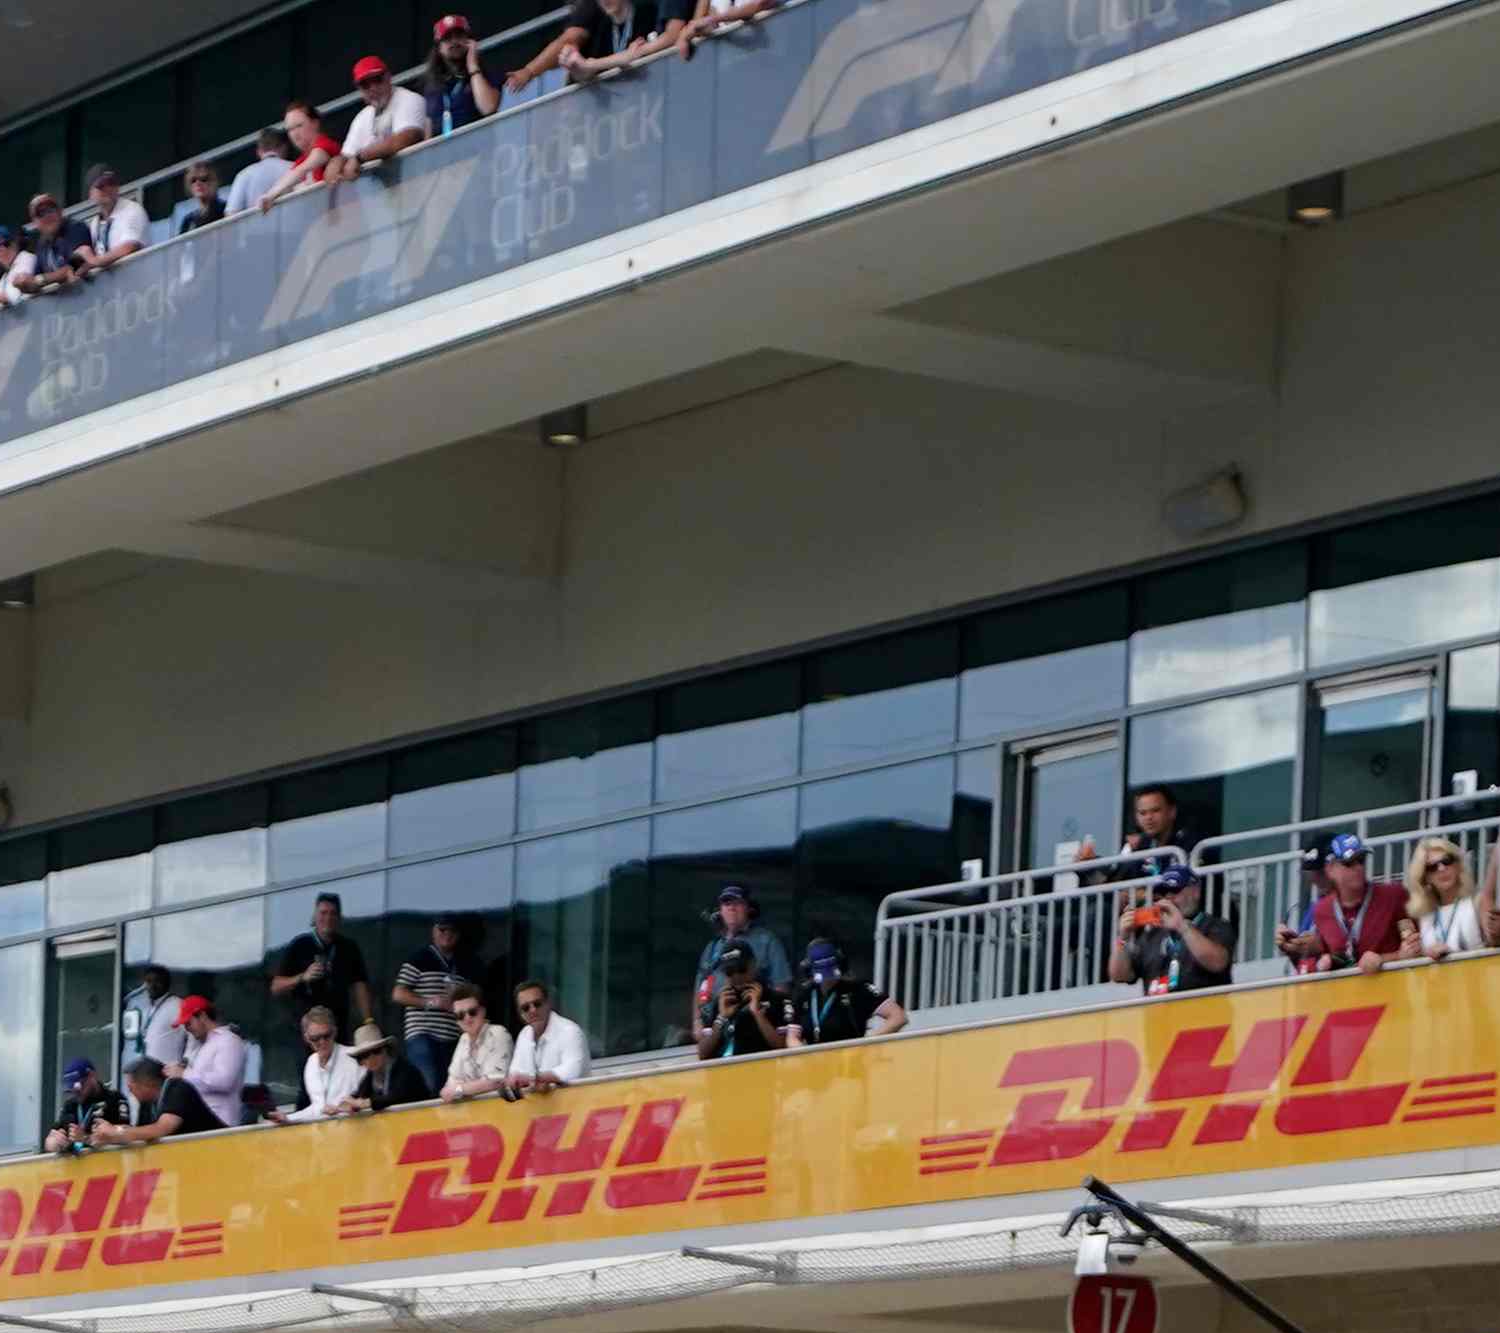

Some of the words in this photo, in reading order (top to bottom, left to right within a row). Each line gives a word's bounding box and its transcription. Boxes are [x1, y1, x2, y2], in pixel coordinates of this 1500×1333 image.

[261, 153, 480, 330] F1
[391, 1098, 701, 1233] DHL
[988, 1004, 1409, 1166] DHL
